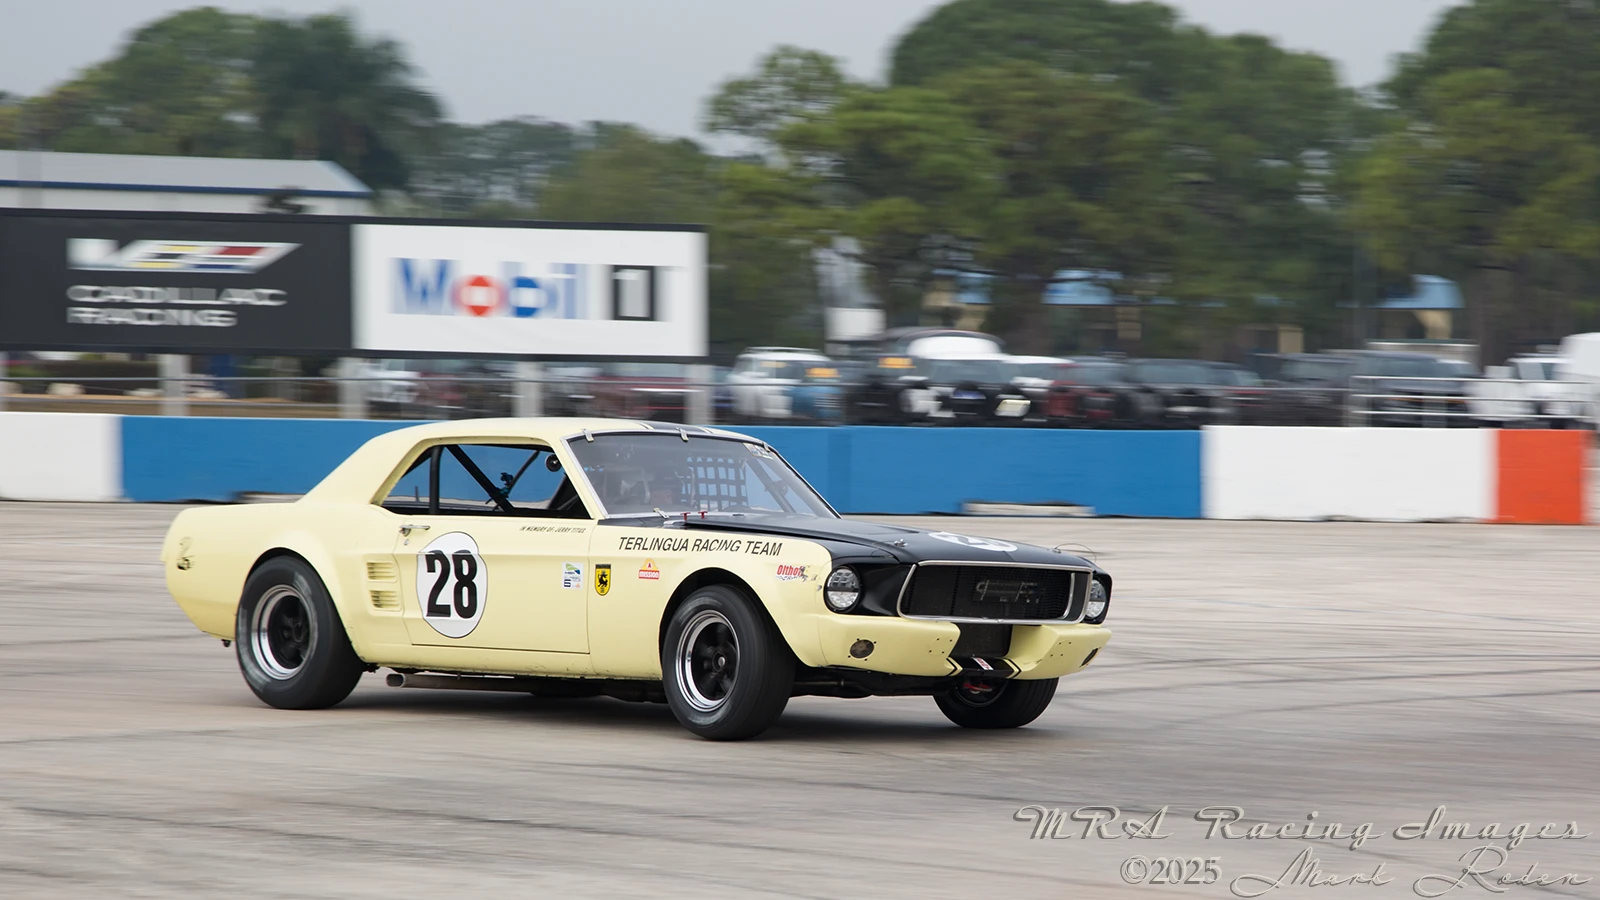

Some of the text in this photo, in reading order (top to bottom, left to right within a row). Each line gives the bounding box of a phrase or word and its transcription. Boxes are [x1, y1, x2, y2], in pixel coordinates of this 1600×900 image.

[66, 285, 287, 306] CADILLAC
[388, 257, 594, 319] Mobil
[66, 307, 238, 327] RACING
[618, 536, 783, 556] TERLINGUA RACING TEAM
[425, 549, 478, 619] 28
